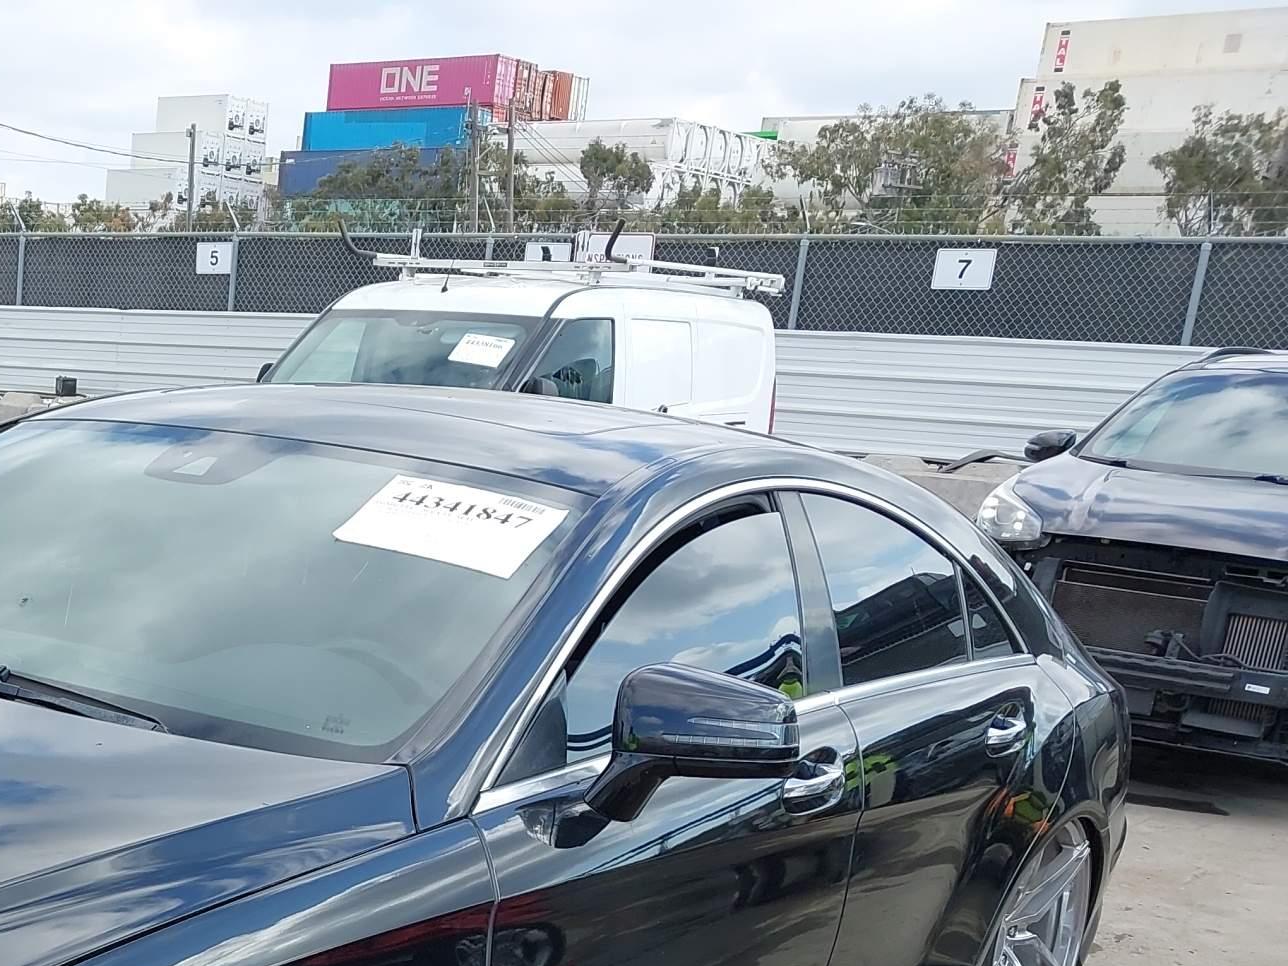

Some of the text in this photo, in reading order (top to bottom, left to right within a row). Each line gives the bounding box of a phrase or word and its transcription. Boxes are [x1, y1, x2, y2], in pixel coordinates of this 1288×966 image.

[380, 65, 440, 94] ONE
[209, 250, 219, 266] 5
[958, 259, 973, 279] 7
[392, 491, 534, 528] 44341847
